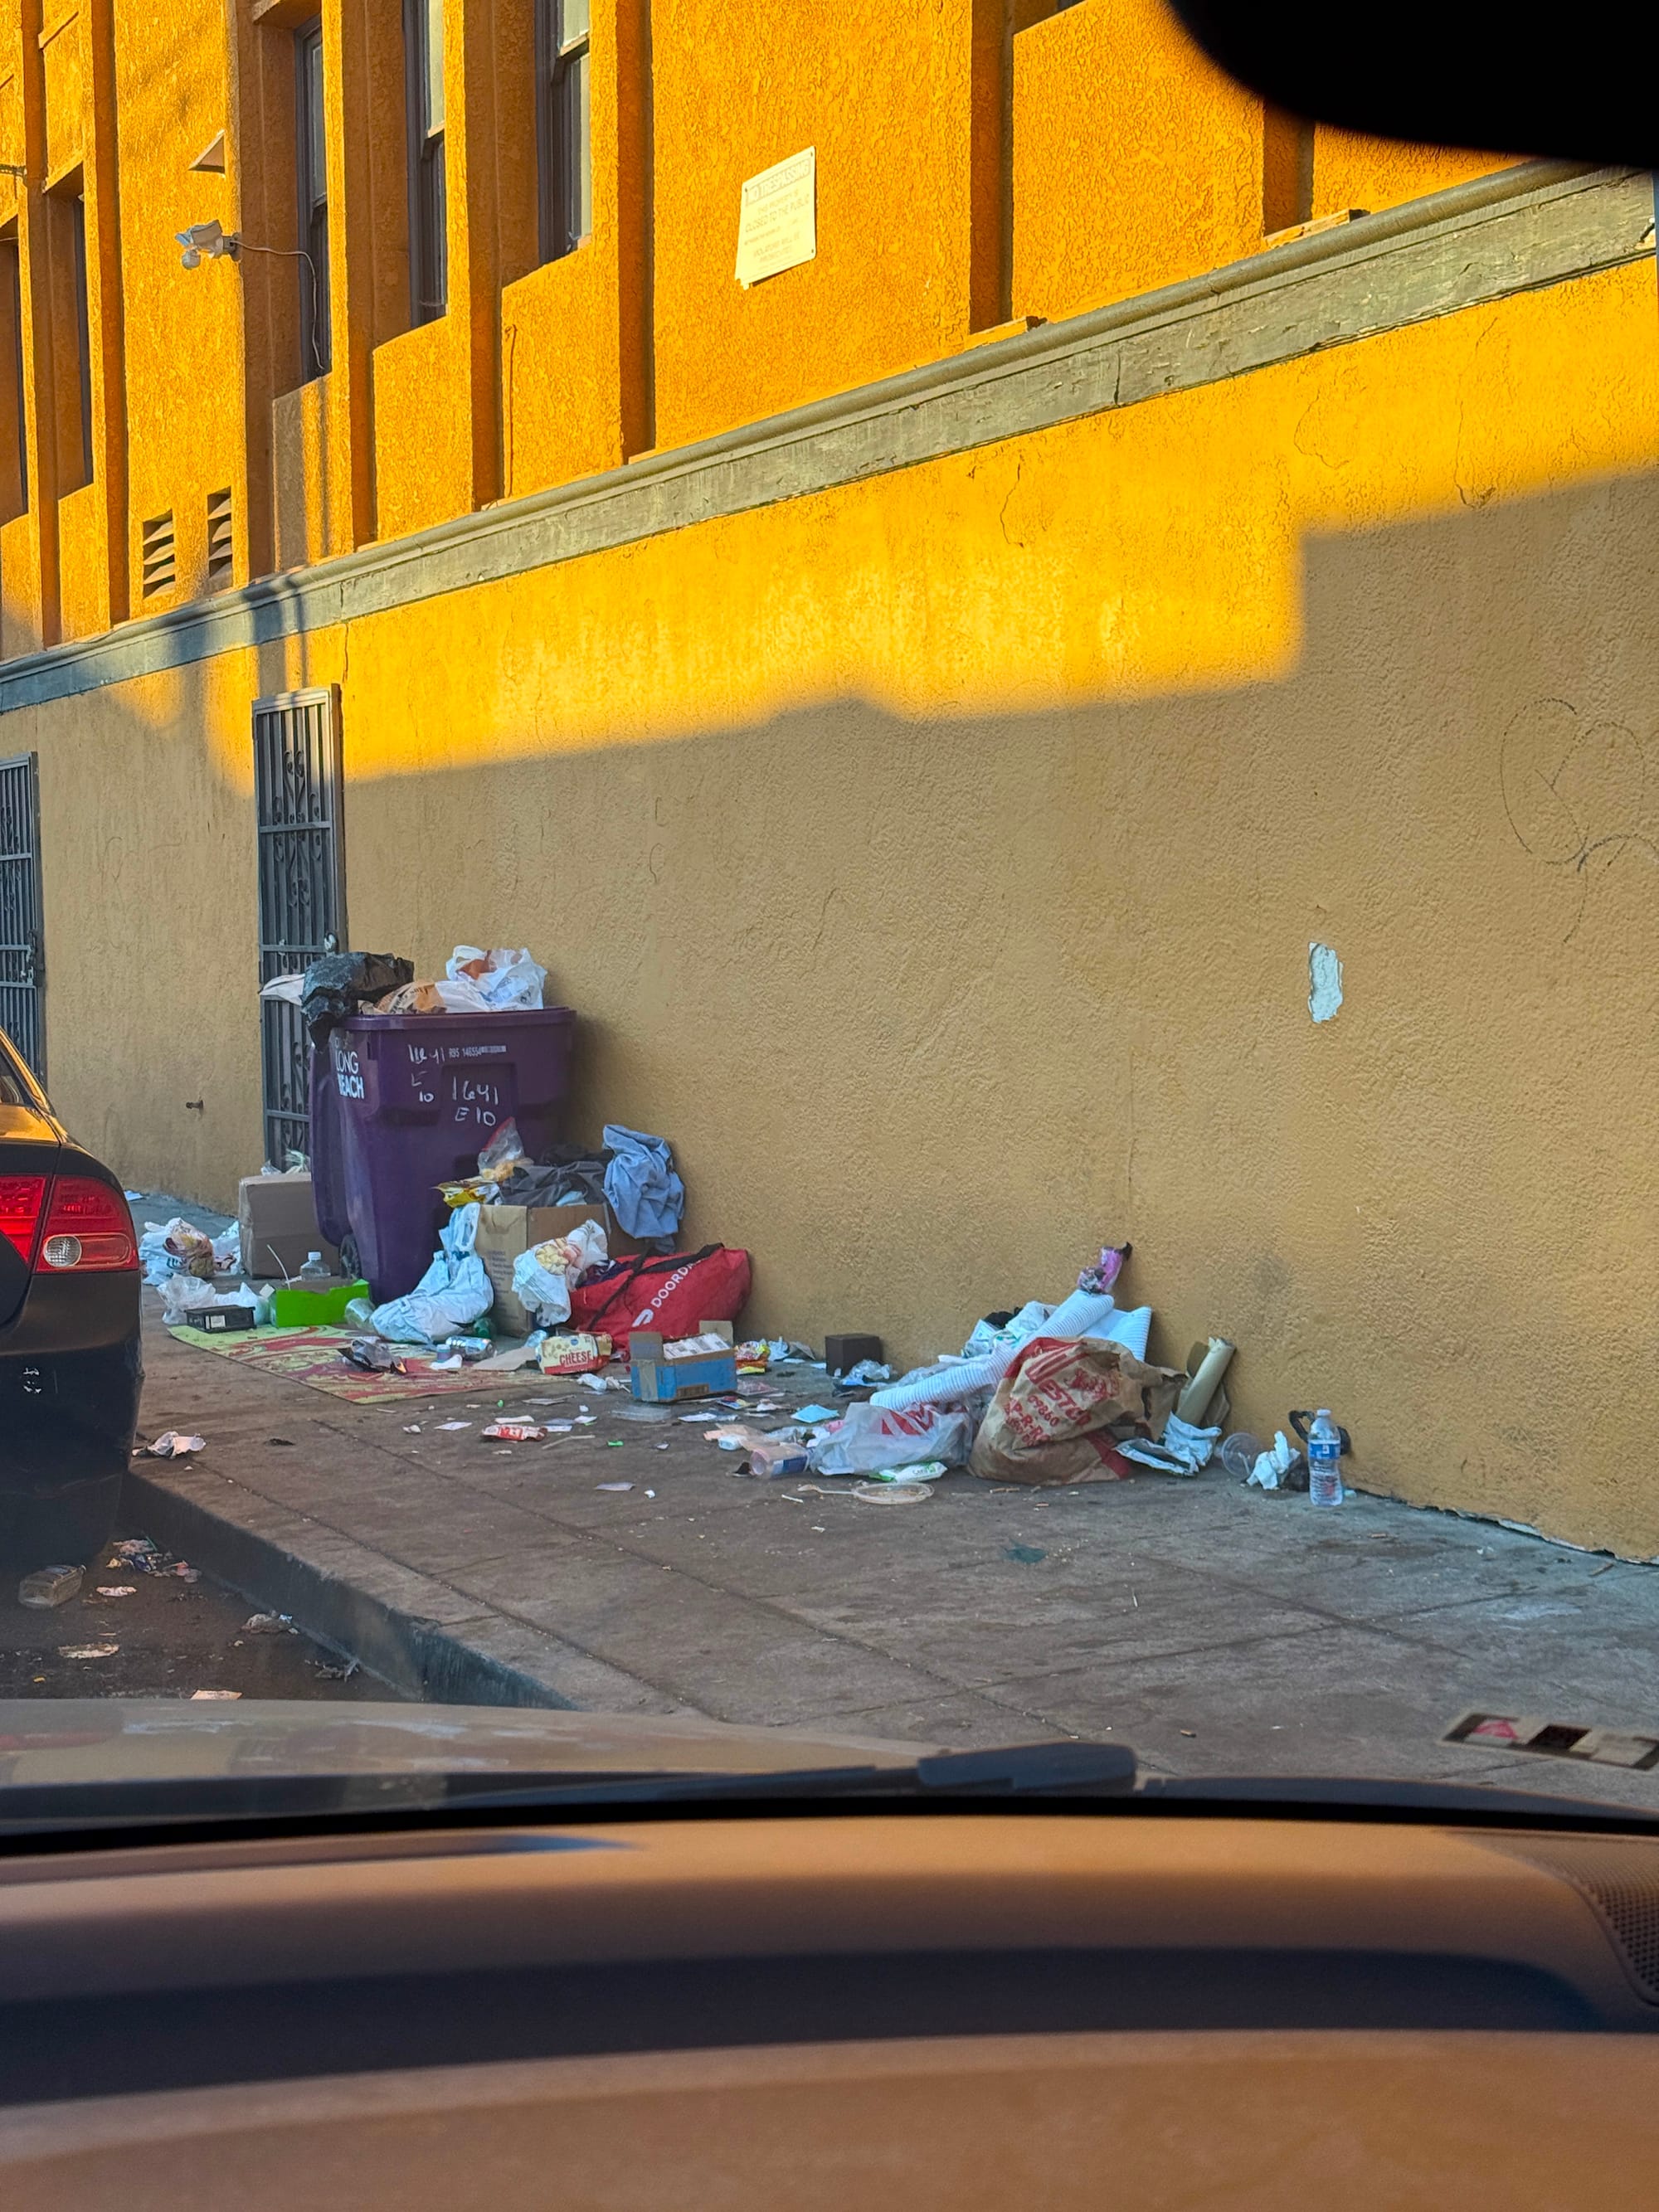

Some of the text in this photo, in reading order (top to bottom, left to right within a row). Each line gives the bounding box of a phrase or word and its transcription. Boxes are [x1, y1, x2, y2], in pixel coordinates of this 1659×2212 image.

[335, 1050, 359, 1074] LONG
[419, 1091, 434, 1103] 10
[452, 1076, 499, 1106] 1641
[455, 1106, 496, 1126] E 10
[650, 1259, 705, 1308] DOORD
